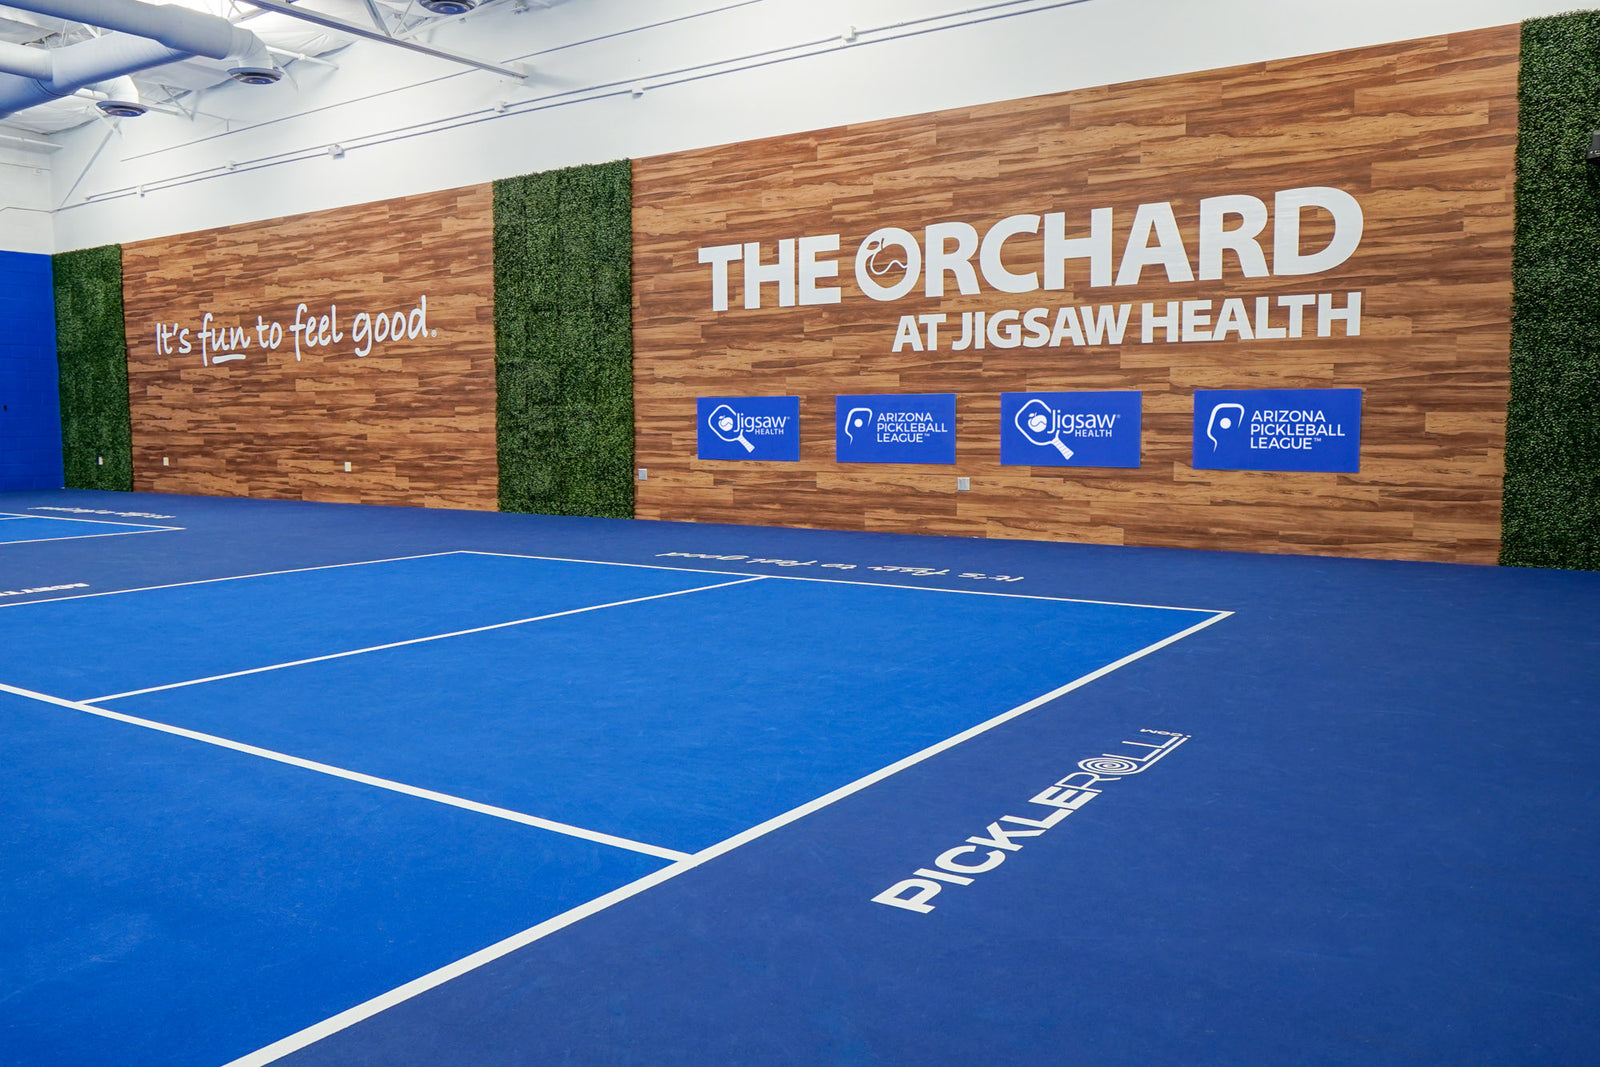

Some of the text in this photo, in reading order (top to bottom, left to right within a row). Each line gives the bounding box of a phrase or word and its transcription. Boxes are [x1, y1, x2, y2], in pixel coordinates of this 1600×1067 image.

[699, 186, 1365, 312] THE ORCHARD
[892, 291, 1363, 353] AT JIGSAW HEALTH
[156, 322, 192, 355] It's
[197, 312, 251, 367] fun
[255, 315, 283, 350] to
[289, 303, 344, 362] feel
[877, 412, 933, 422] ARIZONA
[1251, 410, 1326, 423] ARIZONA
[877, 422, 948, 433] PICKLEBALL
[1074, 429, 1113, 438] HEALTH
[1250, 423, 1346, 437] PICKLEBALL
